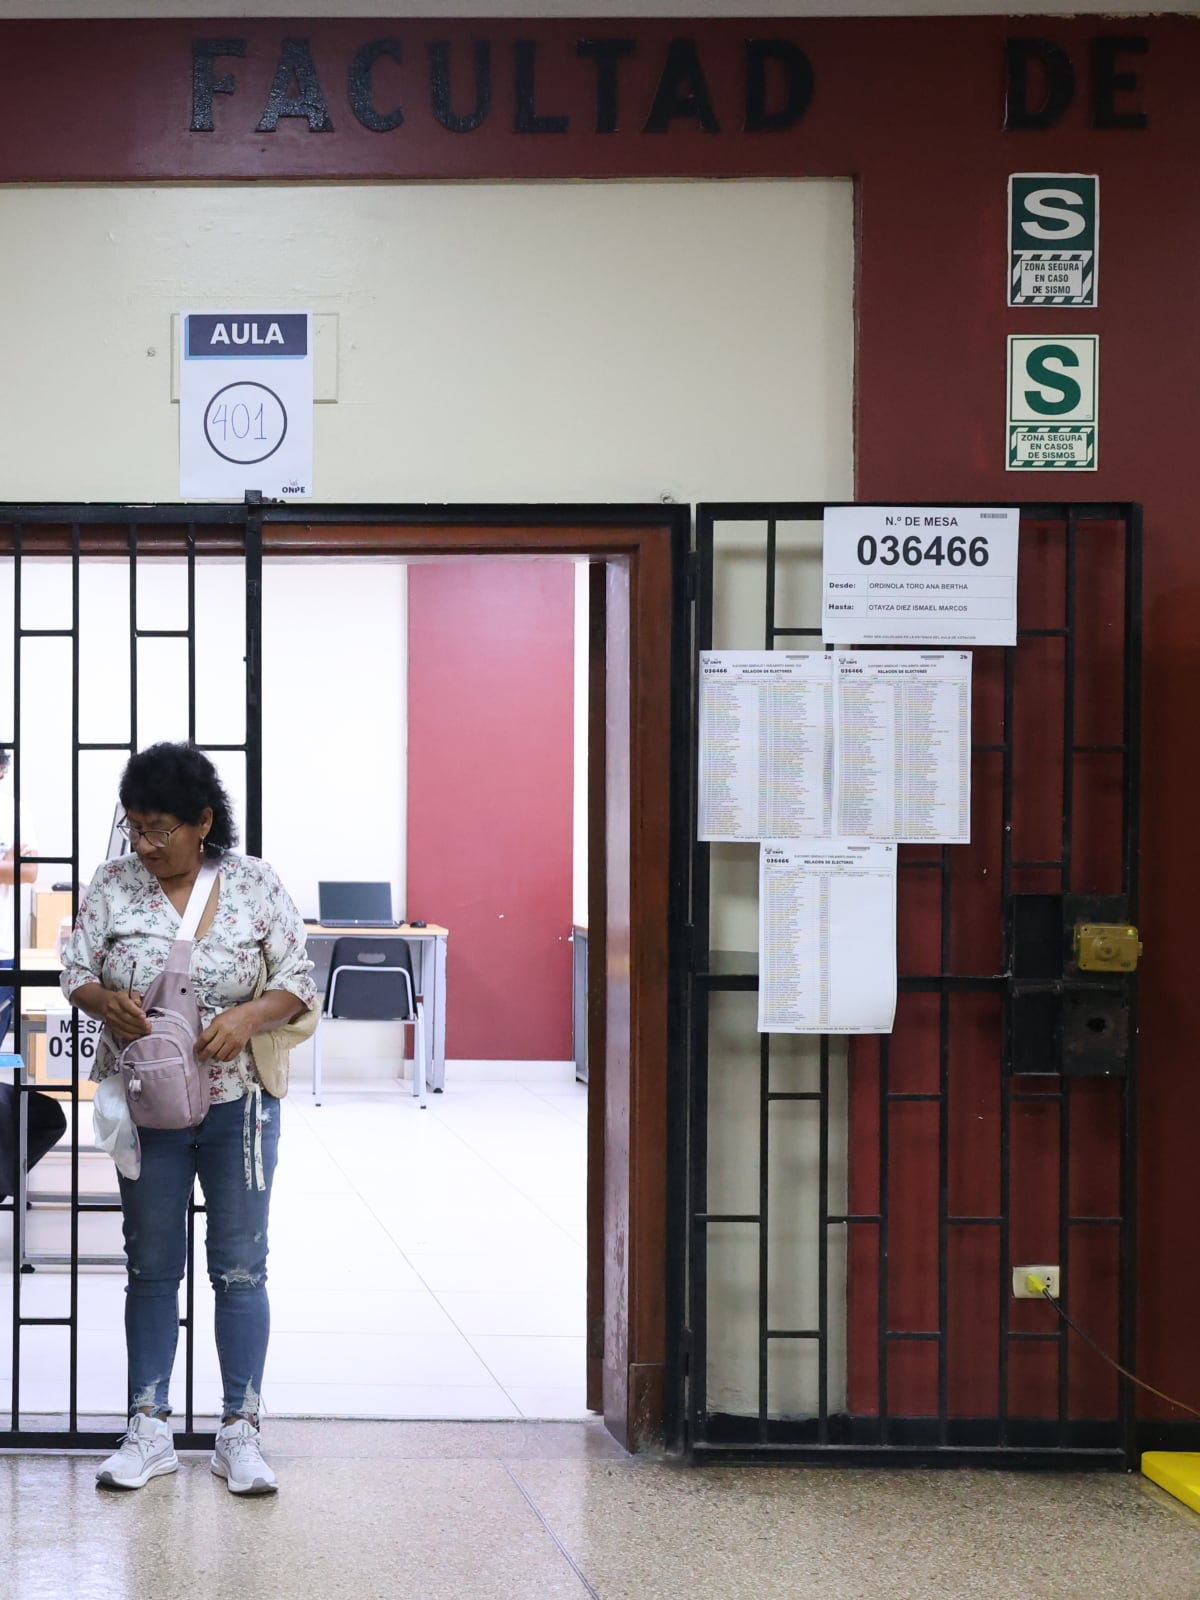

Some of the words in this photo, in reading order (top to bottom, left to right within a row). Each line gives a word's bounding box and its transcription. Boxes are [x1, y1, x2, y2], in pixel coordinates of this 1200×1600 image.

[188, 37, 816, 134] FACULTAD
[1002, 36, 1149, 131] DE
[1020, 188, 1087, 241] S
[1024, 262, 1046, 271] ZONA
[1047, 262, 1080, 271] SEGURA
[1034, 274, 1046, 283] EN
[1047, 274, 1069, 283] CASO
[1032, 285, 1043, 294] DE
[1045, 285, 1071, 294] SISMO
[210, 322, 285, 345] AULA
[1024, 344, 1082, 416] S
[211, 402, 268, 441] 401
[1020, 434, 1045, 442] ZONA
[1047, 434, 1083, 442] SEGURA
[281, 486, 306, 494] ONPE
[904, 516, 921, 527] DE
[923, 517, 959, 527] MESA
[857, 535, 990, 567] 036466
